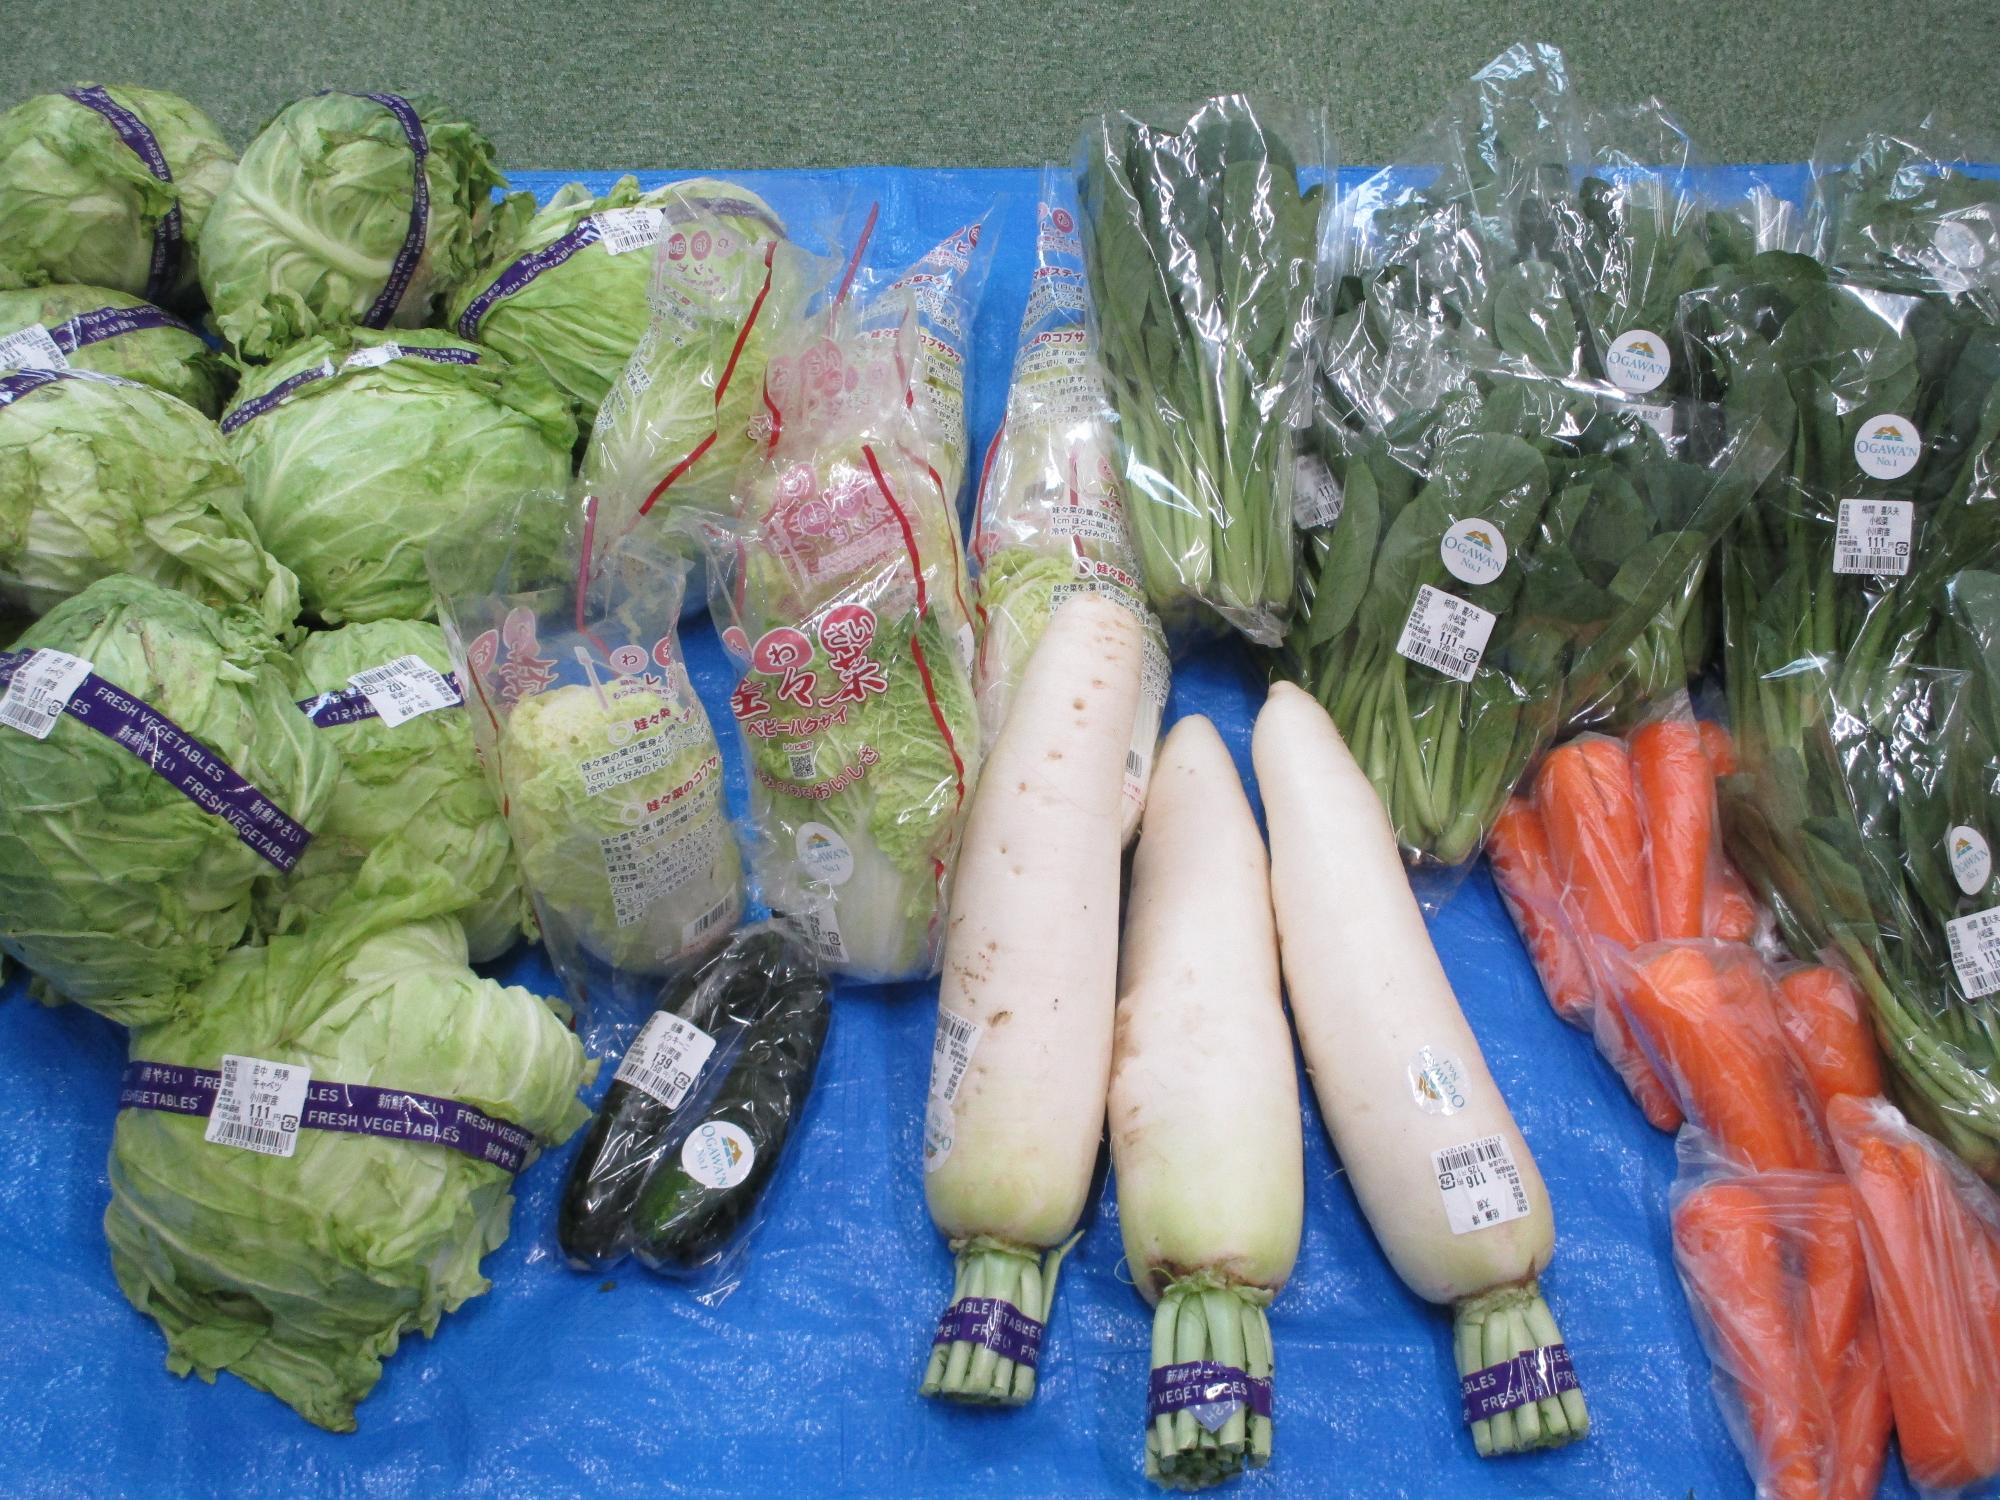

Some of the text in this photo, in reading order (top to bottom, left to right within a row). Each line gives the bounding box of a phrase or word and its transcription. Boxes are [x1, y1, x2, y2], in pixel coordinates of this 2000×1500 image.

[150, 143, 169, 181] FRESH
[1856, 440, 1918, 457] OGAWA'N
[1867, 537, 1884, 547] 111
[1444, 536, 1503, 572] OGAWA'N
[1448, 613, 1467, 627] 小松菜
[823, 616, 874, 648] さい
[1440, 632, 1457, 647] 111
[1439, 643, 1450, 652] 120
[386, 680, 407, 692] 102
[748, 705, 848, 738] ベビーハクサイ
[95, 687, 225, 782] FRESH VEGETABLES
[586, 770, 606, 783] 1cm
[181, 775, 227, 815] FRESH
[652, 1053, 673, 1070] 139
[252, 1079, 282, 1092] キャベツ
[248, 1103, 270, 1119] 111
[250, 1117, 264, 1127] 120
[308, 1110, 460, 1143] FRESH VEGETABLES
[456, 1109, 496, 1134] FRESH
[1468, 1165, 1480, 1174] 125
[1466, 1172, 1487, 1188] 116
